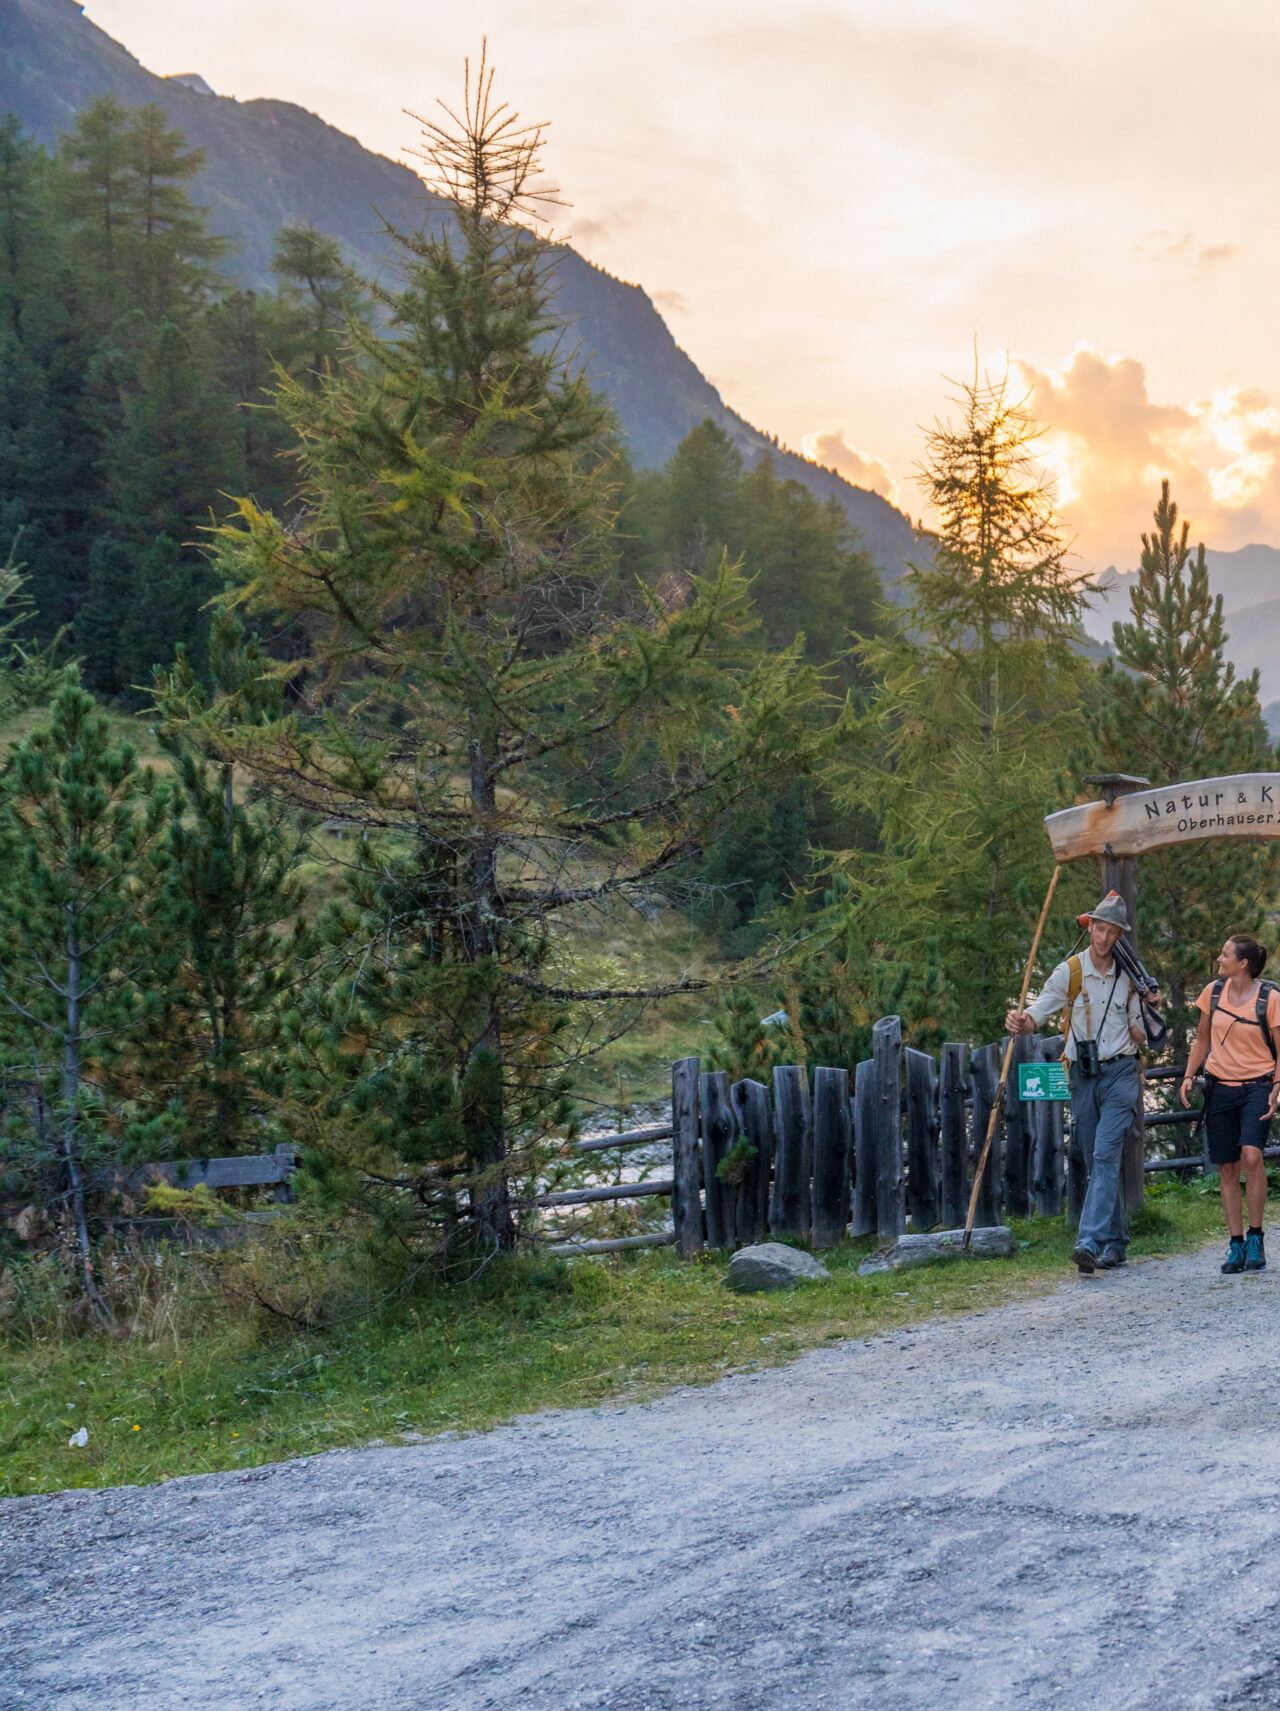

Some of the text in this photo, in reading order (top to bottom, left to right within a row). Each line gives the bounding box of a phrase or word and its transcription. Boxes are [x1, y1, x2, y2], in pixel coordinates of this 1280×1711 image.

[1144, 792, 1224, 819] Natur
[1237, 791, 1248, 804] &
[1177, 812, 1274, 832] Oberhauser
